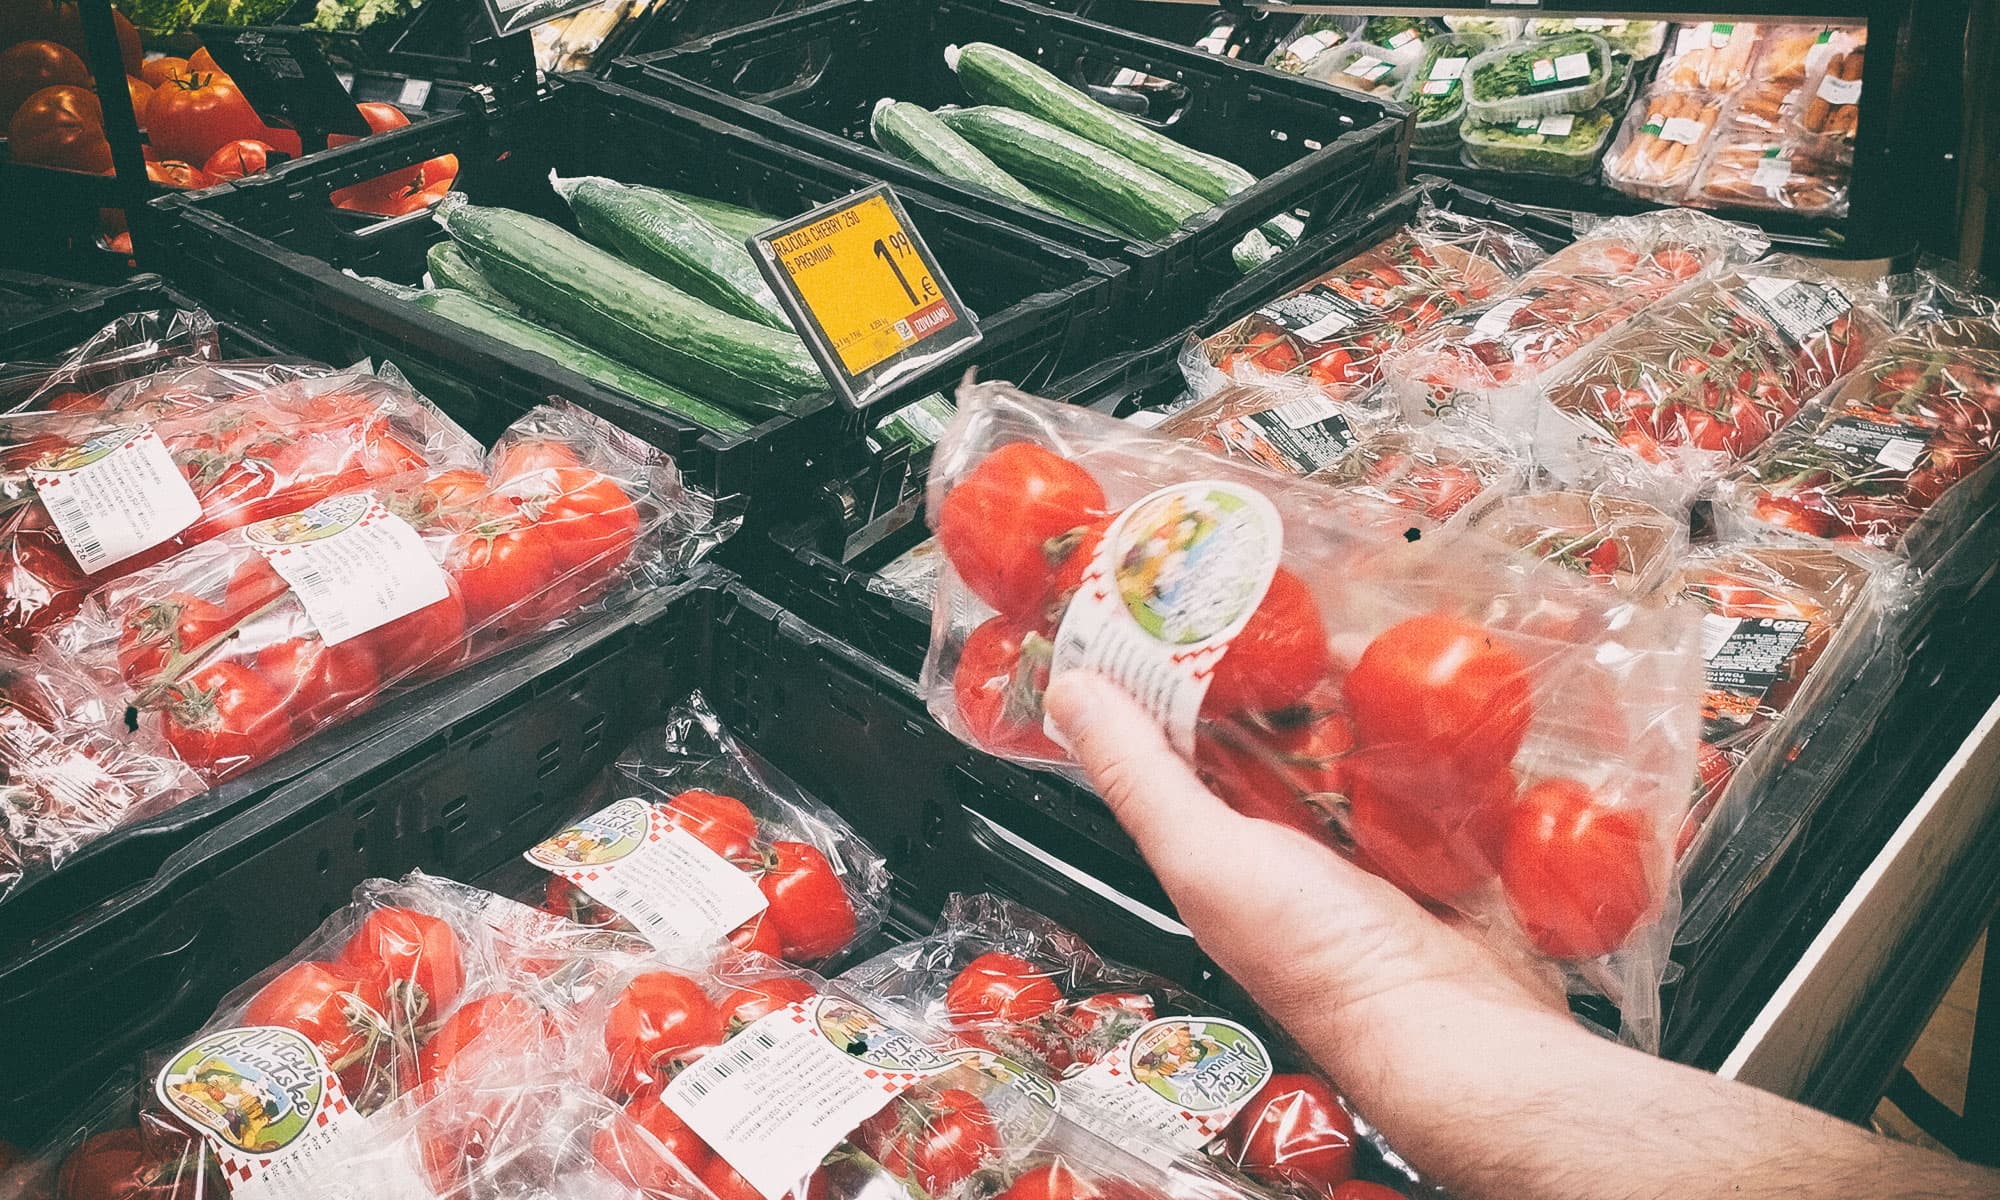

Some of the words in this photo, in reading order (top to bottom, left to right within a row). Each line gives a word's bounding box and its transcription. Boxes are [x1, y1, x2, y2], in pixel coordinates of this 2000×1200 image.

[809, 217, 843, 242] CHERRY
[841, 210, 861, 228] 250
[785, 260, 796, 275] G
[793, 244, 837, 272] PREMIUM
[203, 1036, 312, 1117] Hrvatske
